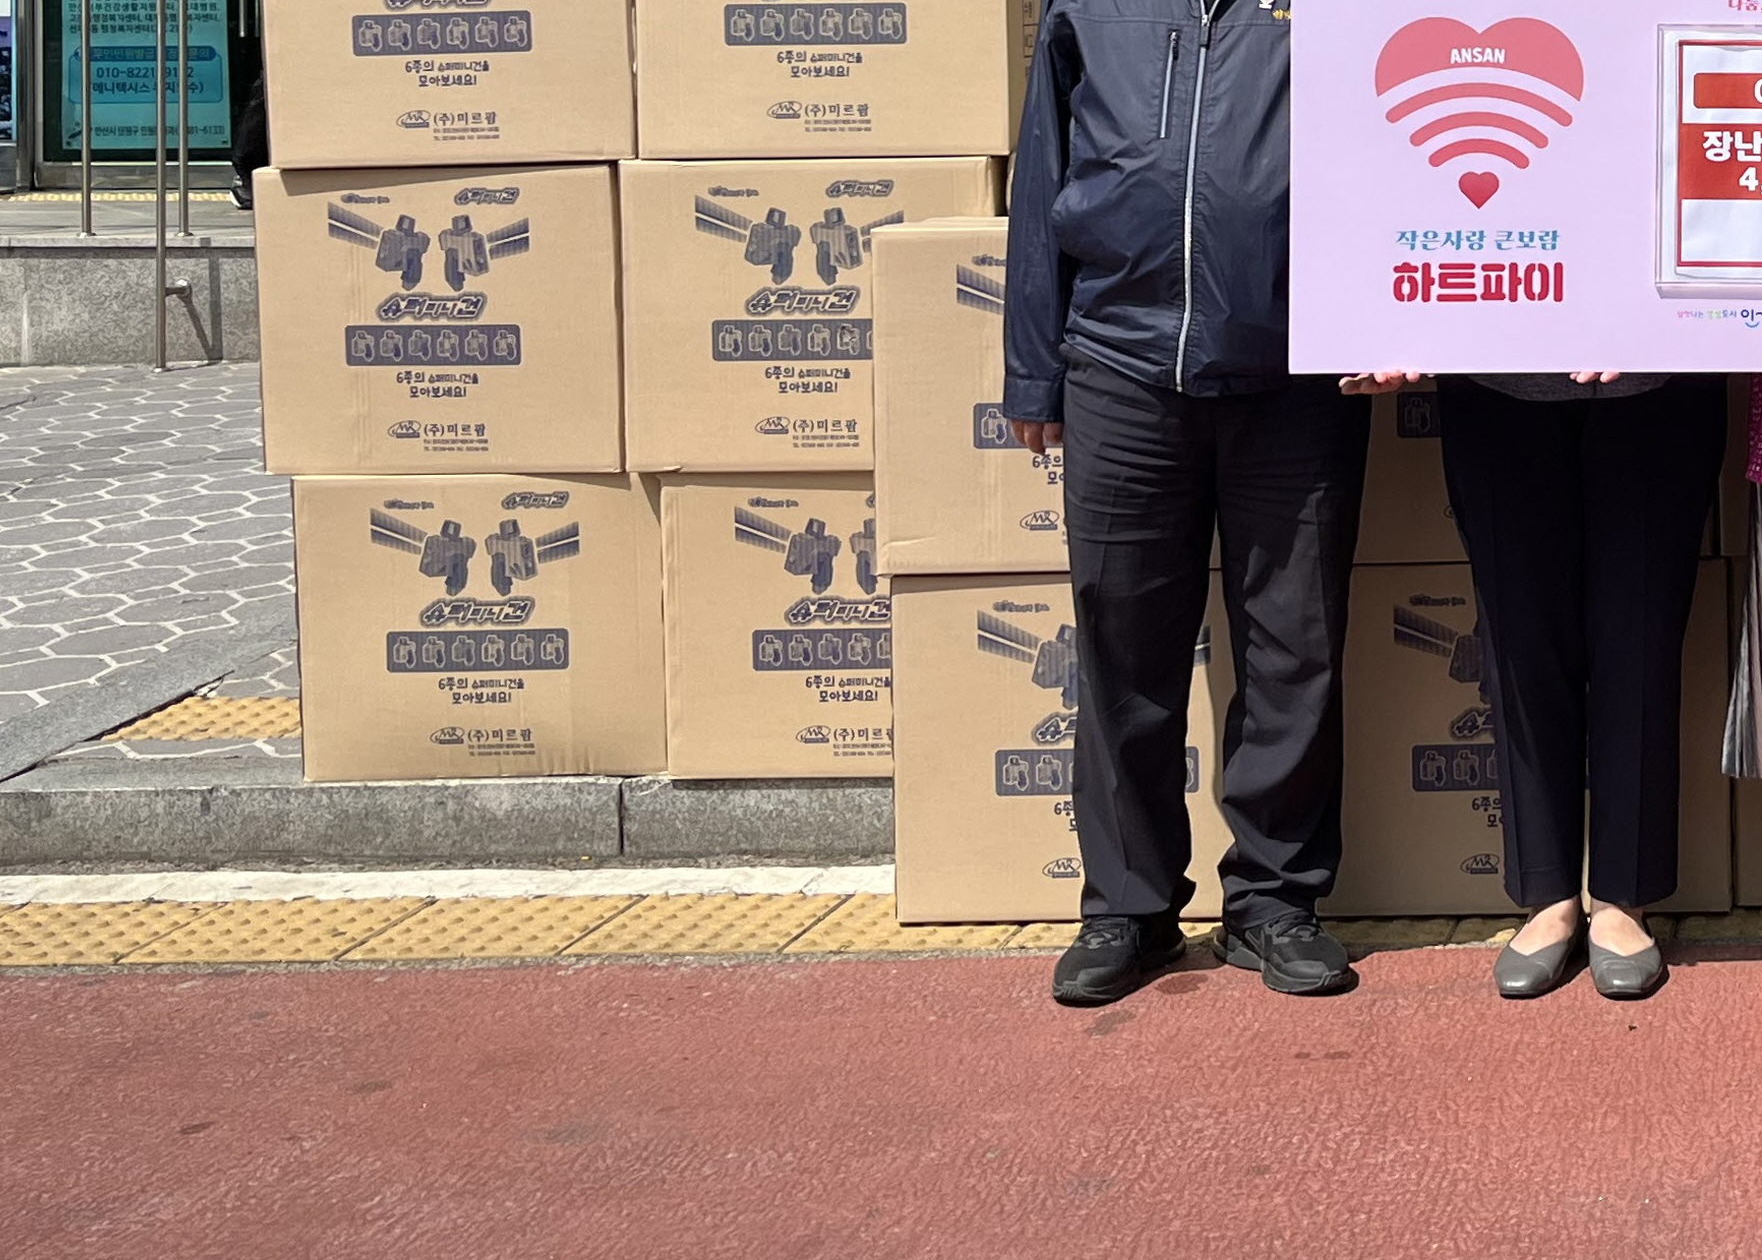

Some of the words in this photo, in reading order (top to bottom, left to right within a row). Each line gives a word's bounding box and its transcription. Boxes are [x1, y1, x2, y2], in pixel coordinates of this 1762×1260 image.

[777, 51, 806, 65] 6종의
[1450, 47, 1506, 64] ANSAN
[405, 60, 434, 74] 6종의
[790, 65, 849, 78] 모아보세요!
[419, 74, 477, 87] 모아보세요!
[804, 103, 869, 118] (주)미르팜
[433, 111, 497, 126] (주)미르팜
[1395, 230, 1486, 251] 작은사랑
[1494, 230, 1559, 251] 큰보람
[1393, 262, 1563, 302] 하트파이
[380, 295, 483, 319] 슈퍼미니건
[749, 289, 857, 313] 슈퍼미니건
[396, 371, 425, 385] 6종의
[764, 367, 794, 380] 6종의
[409, 386, 466, 398] 모아보세요!
[778, 381, 838, 394] 모아보세요!
[424, 423, 487, 438] (주)미르팜
[792, 419, 858, 434] (주)미르팜
[423, 600, 531, 624] 슈퍼미니건
[438, 677, 468, 690] 6종의
[806, 676, 835, 689] 6종의
[452, 692, 511, 704] 모아보세요!
[819, 691, 878, 702] 모아보세요!
[467, 728, 533, 742] (주)미르팜
